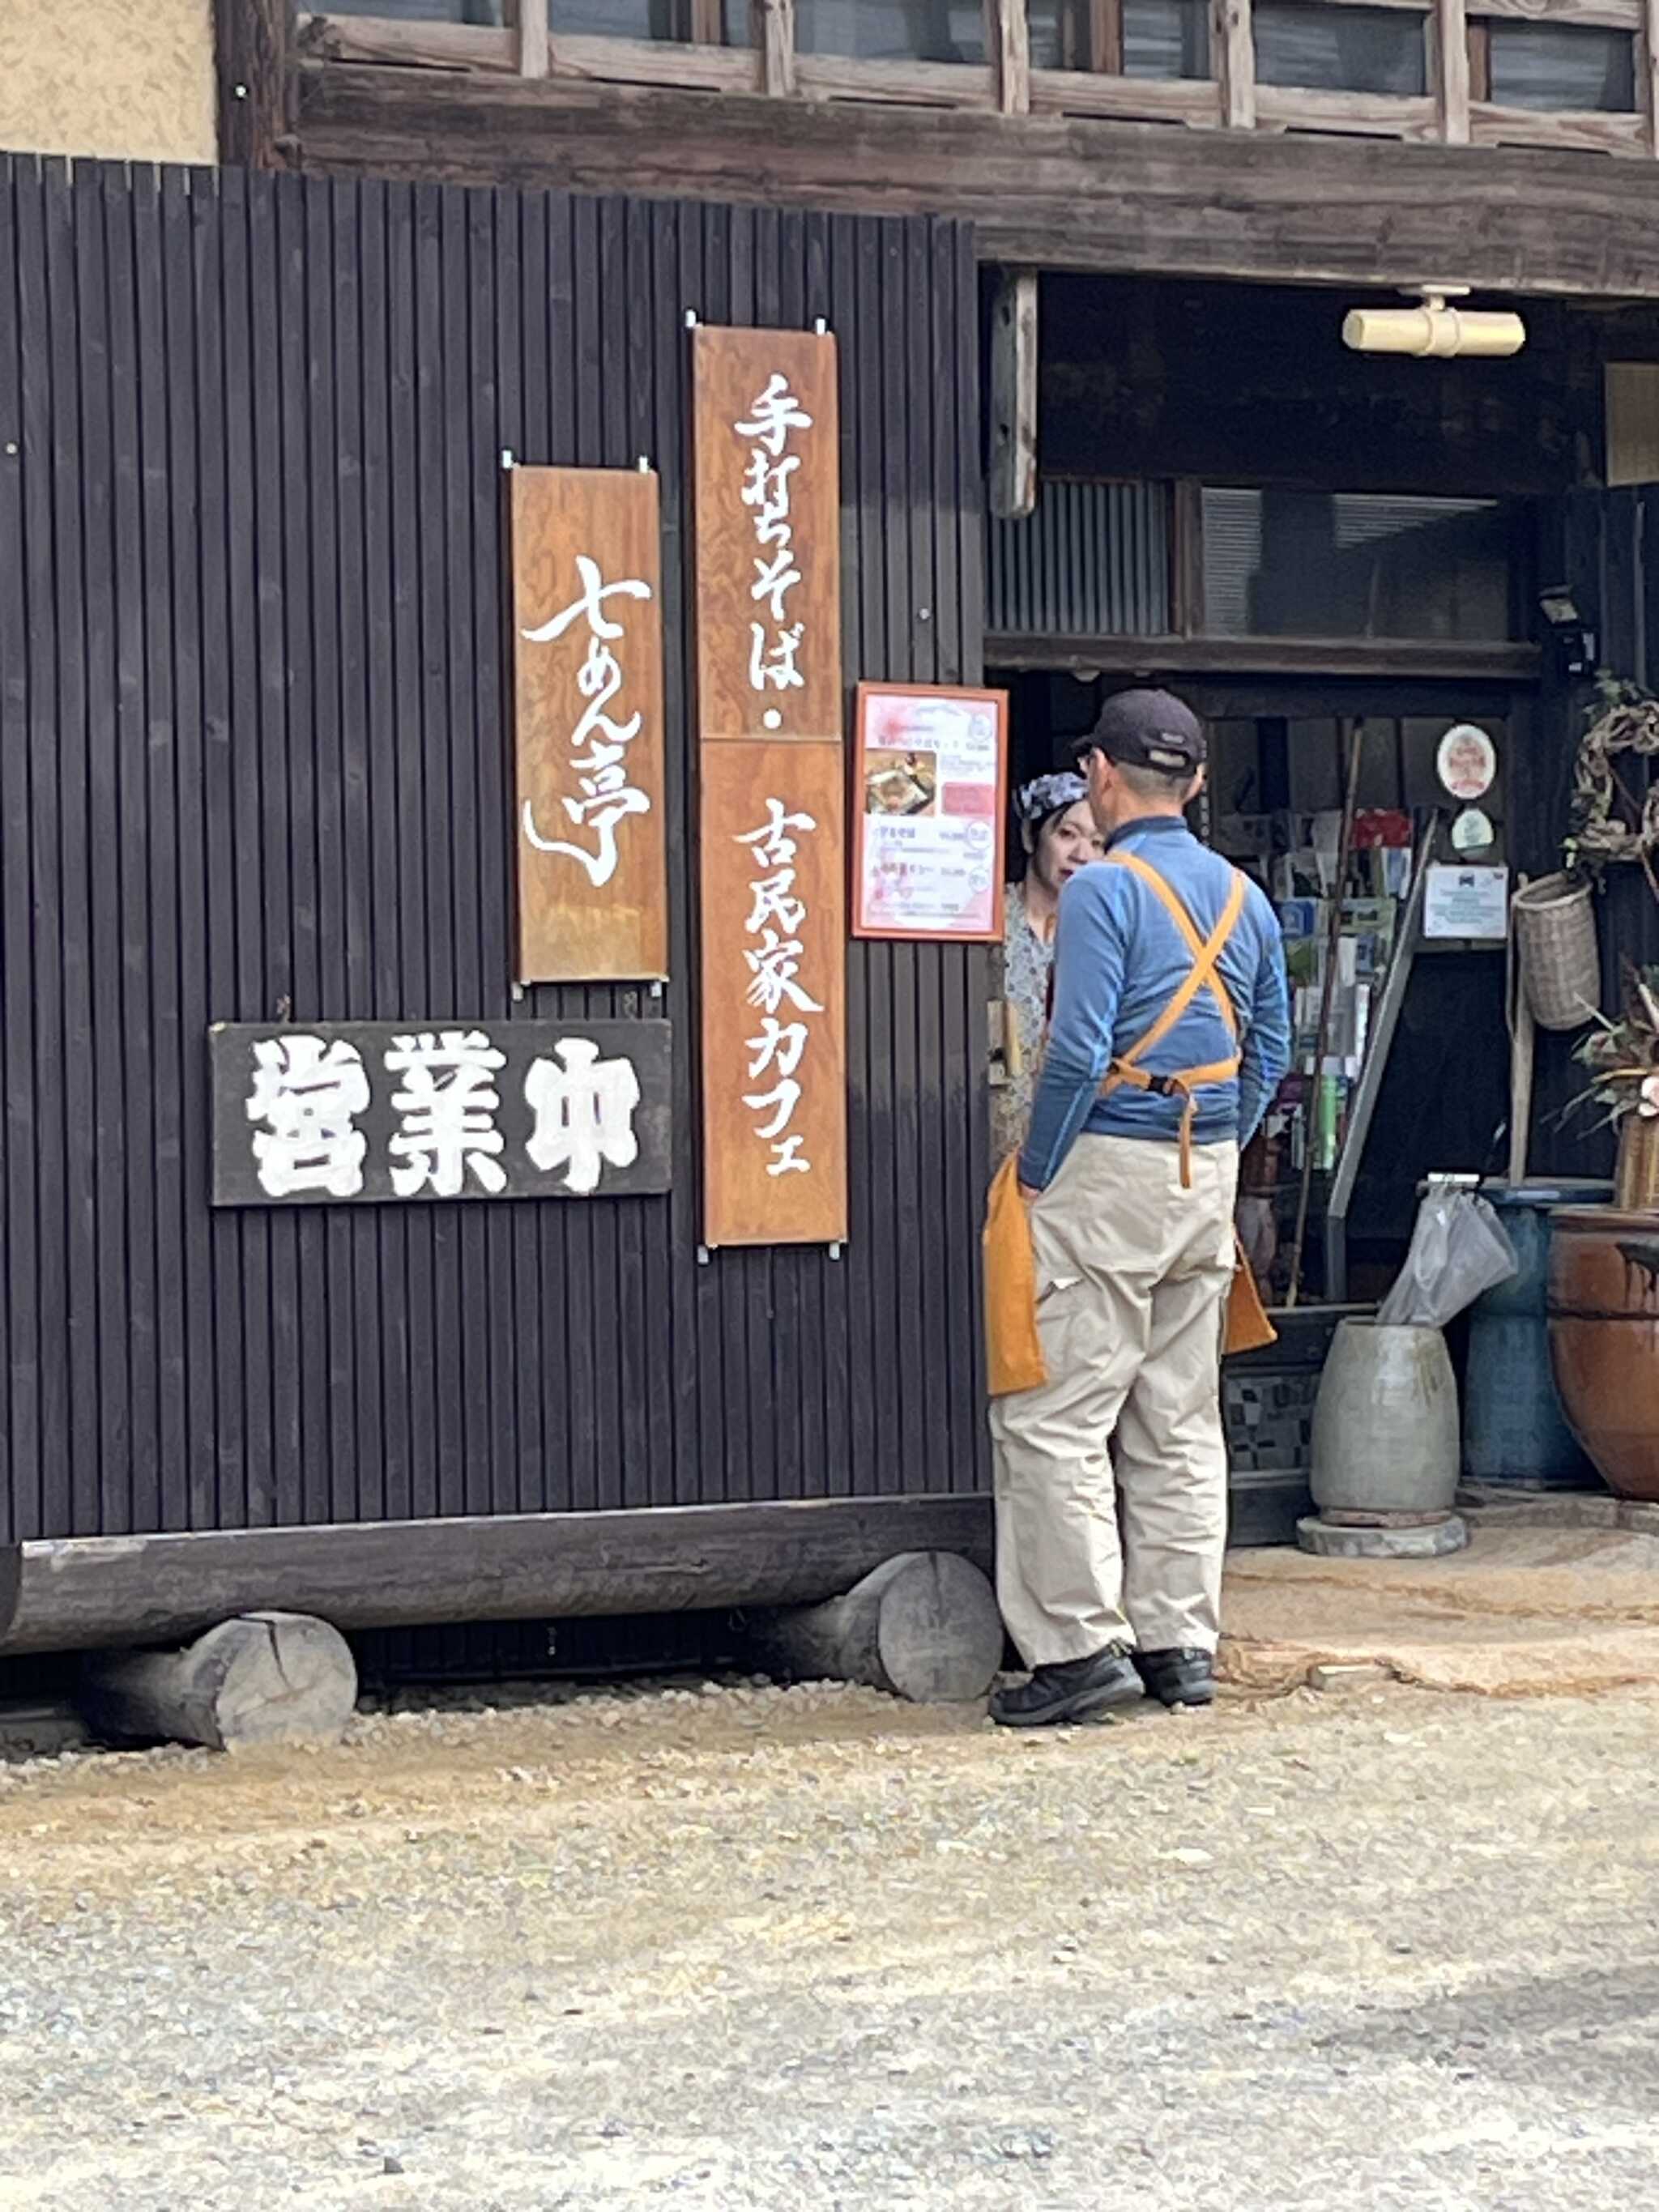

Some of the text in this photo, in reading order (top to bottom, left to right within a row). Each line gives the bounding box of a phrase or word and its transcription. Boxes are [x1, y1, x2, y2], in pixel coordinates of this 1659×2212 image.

[520, 555, 652, 887] 七めん亭
[245, 1030, 640, 1197] 営業中
